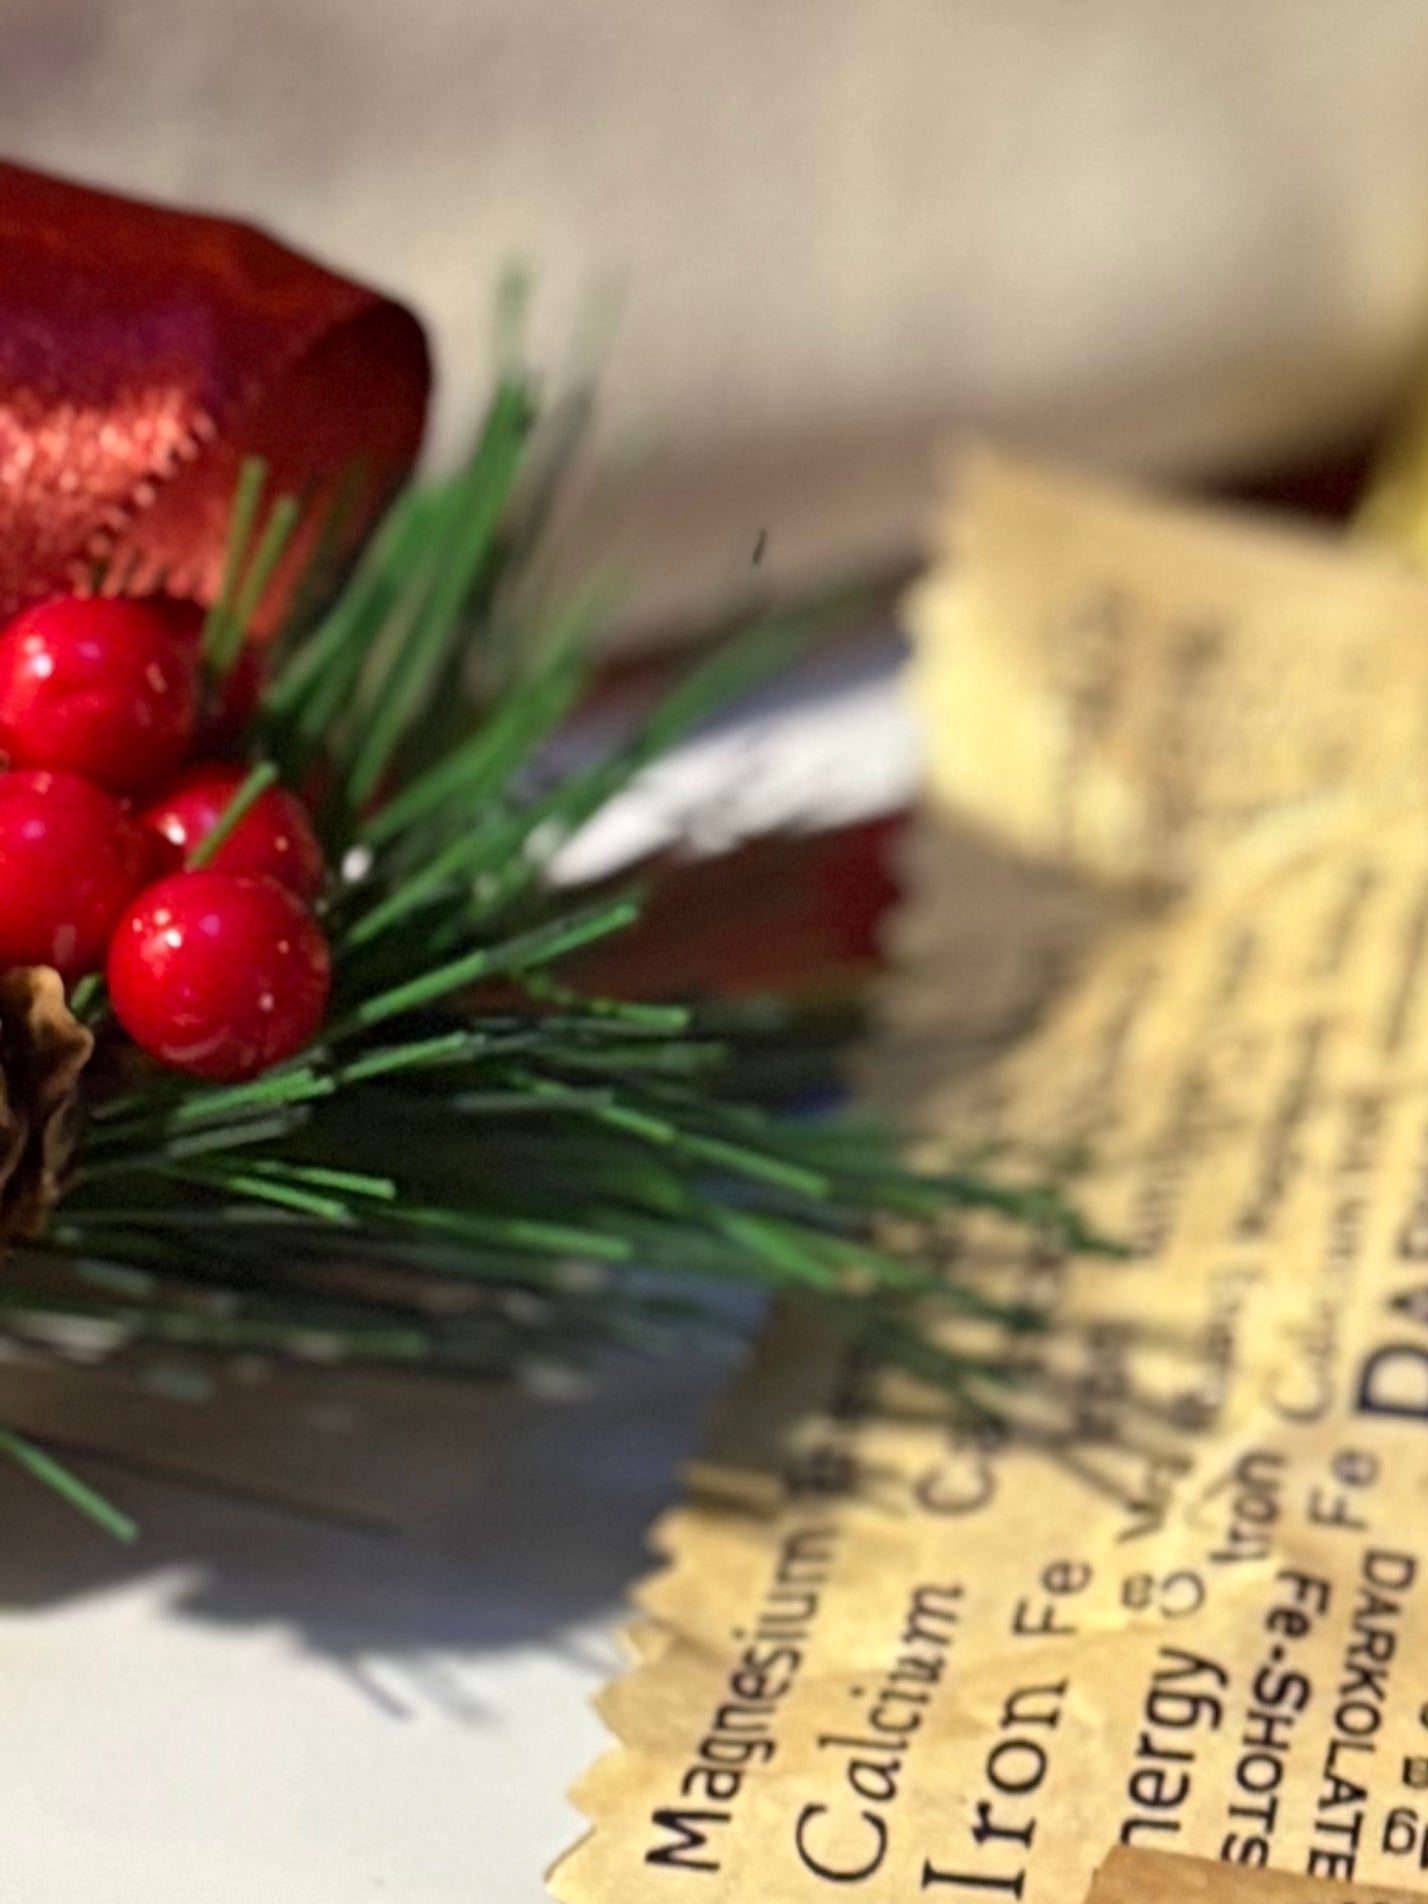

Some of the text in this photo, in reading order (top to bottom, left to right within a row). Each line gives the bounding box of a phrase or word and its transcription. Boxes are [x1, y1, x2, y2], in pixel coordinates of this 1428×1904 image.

[1305, 1446, 1381, 1534] Fe
[645, 1526, 838, 1873] Magnesium
[795, 1583, 964, 1886] Calcium
[920, 1558, 1093, 1902] Iron Fe
[1221, 1569, 1331, 1868] Fe-SHOTS
